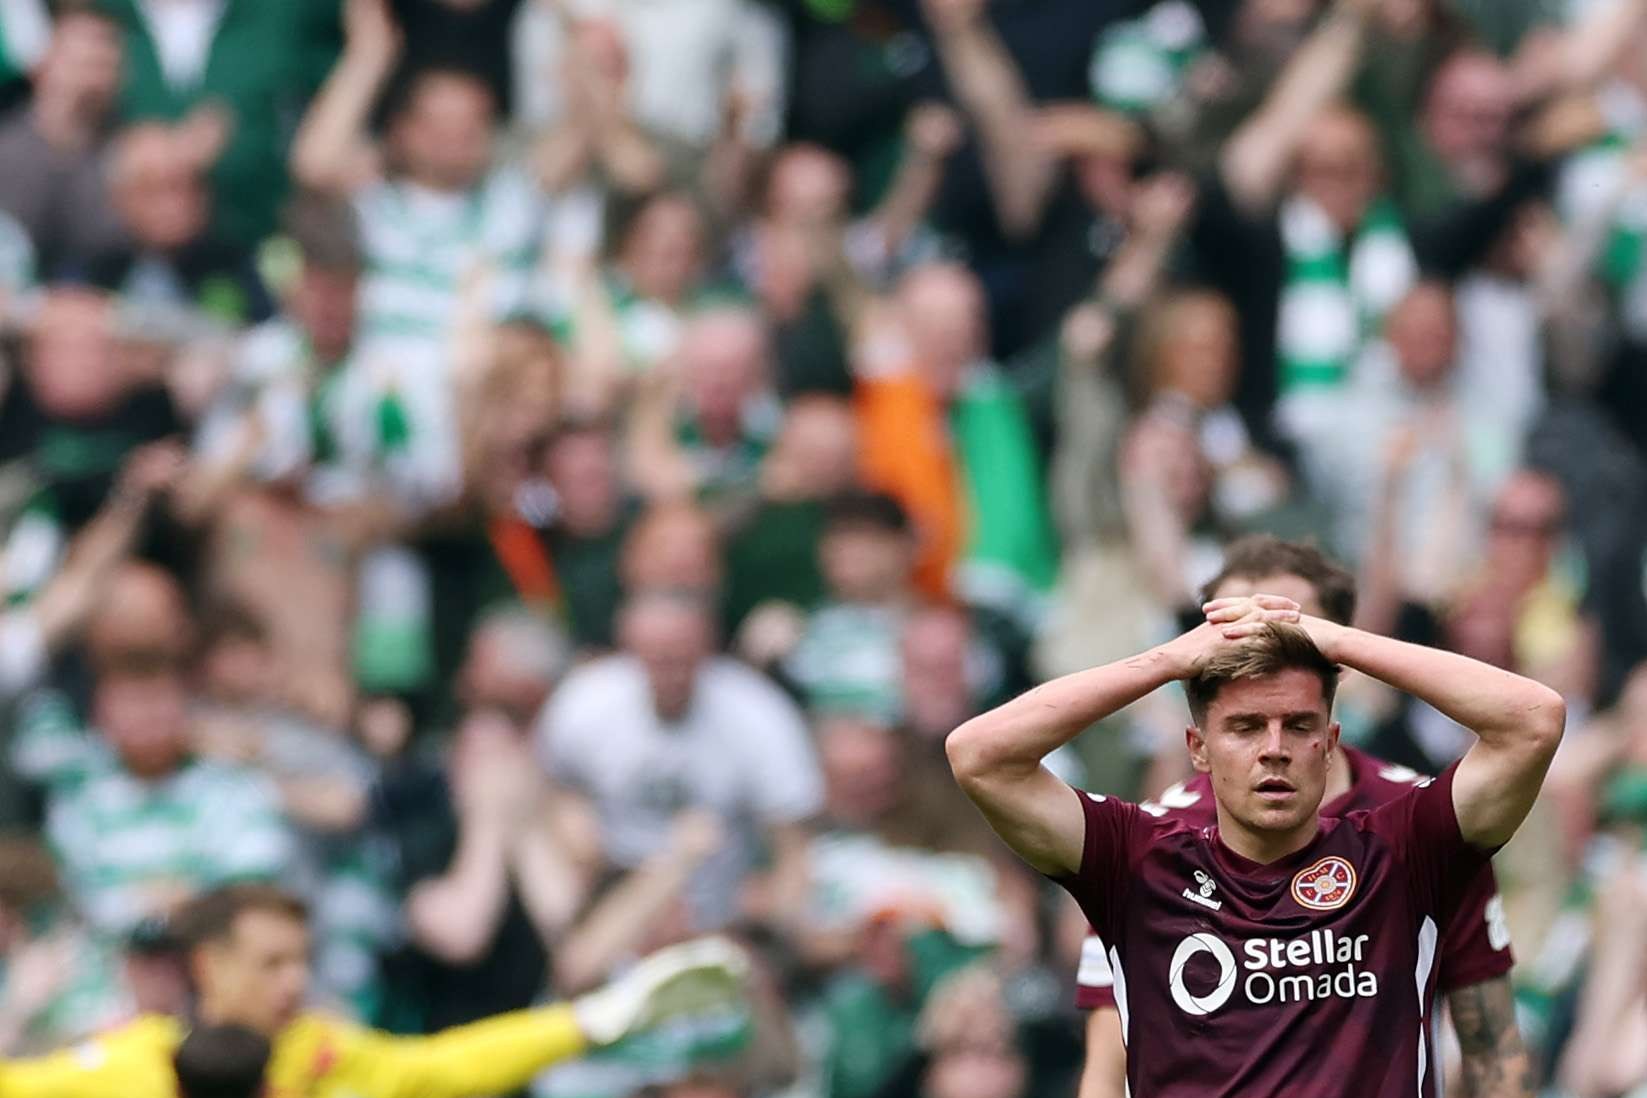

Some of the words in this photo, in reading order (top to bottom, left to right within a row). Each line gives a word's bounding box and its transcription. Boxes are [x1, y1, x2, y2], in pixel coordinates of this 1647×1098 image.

[1182, 888, 1222, 911] hummel
[1244, 928, 1369, 970] Stellar
[1245, 963, 1378, 1004] Omada
